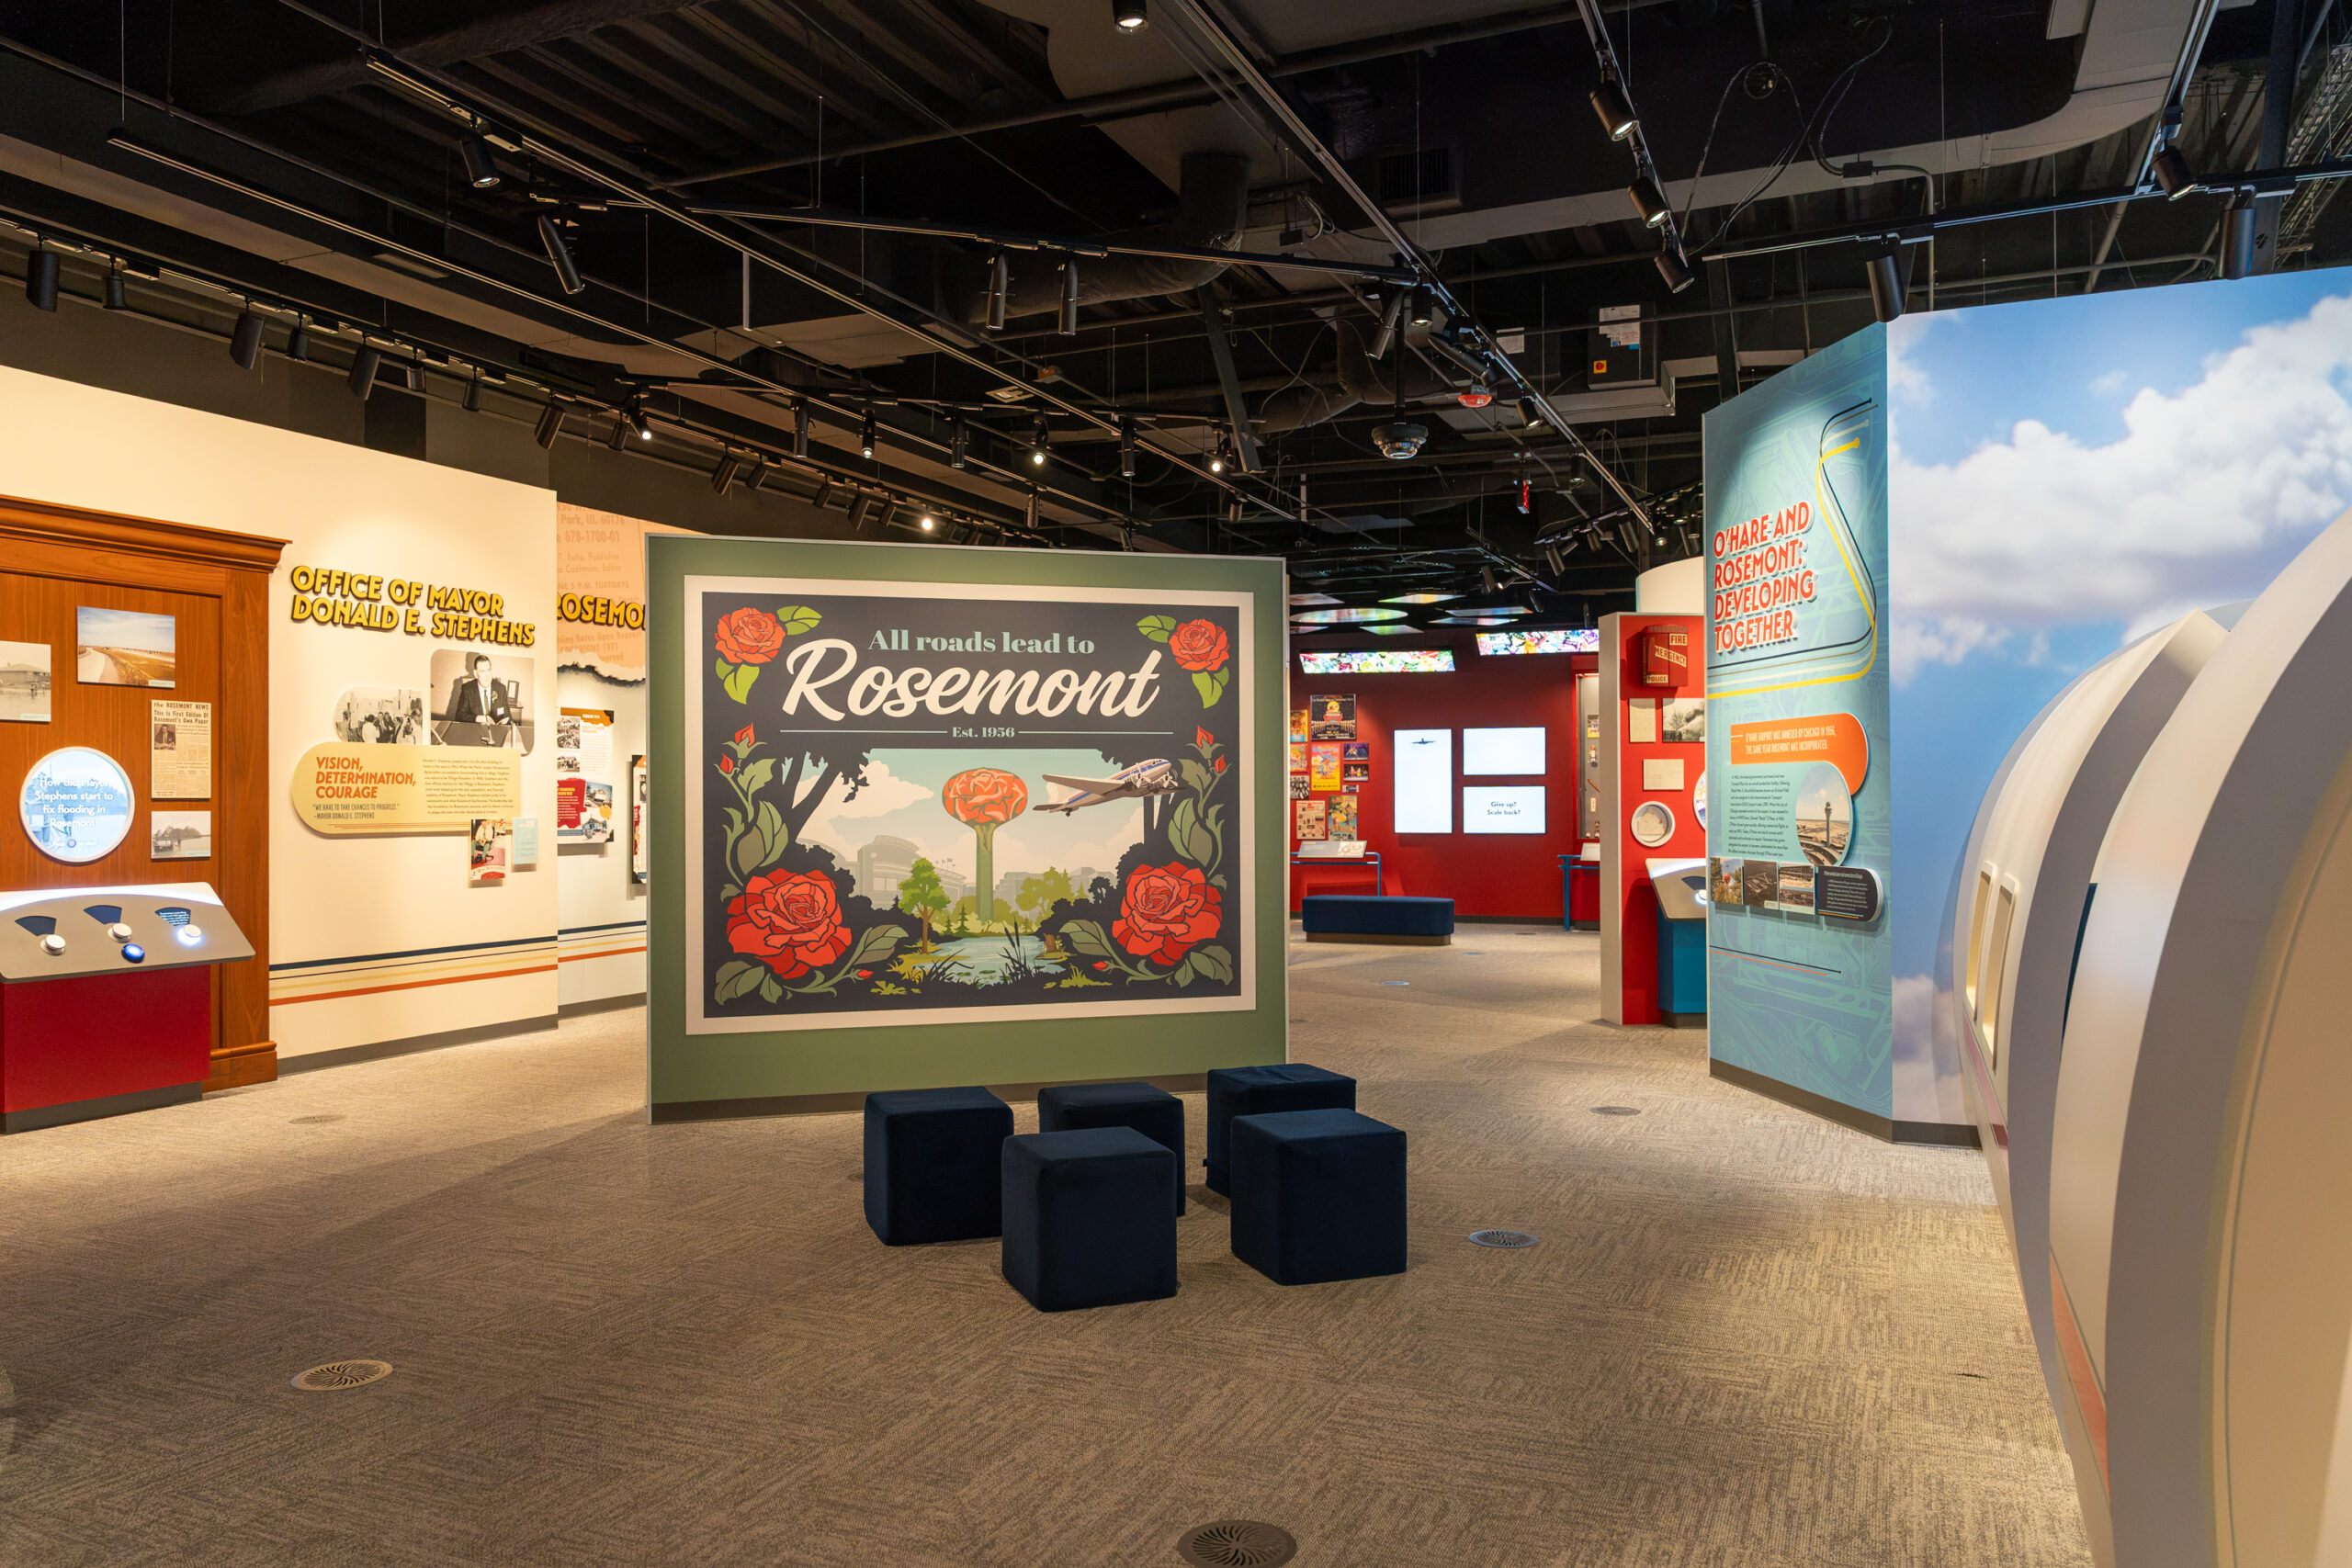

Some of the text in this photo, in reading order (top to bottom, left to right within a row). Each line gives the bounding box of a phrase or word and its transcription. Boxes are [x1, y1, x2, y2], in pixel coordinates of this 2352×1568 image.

[561, 514, 583, 526] Park,
[565, 530, 620, 543] 678-1700-01
[1713, 502, 1809, 558] O'HARE AND
[1714, 538, 1803, 590] ROSEMONT:
[291, 565, 504, 617] OFFICE OF MAYOR
[595, 580, 630, 589] TUESDAYS
[1714, 570, 1814, 620] DEVELOPING
[291, 594, 535, 646] DONALD E. STEPHENS
[1714, 609, 1794, 652] TOGETHER
[869, 629, 1095, 654] All roads lead to
[1671, 635, 1687, 644] FIRE
[781, 638, 1163, 722] Rosemont
[952, 727, 1015, 739] Est. 1956
[1758, 731, 1772, 742] AIRPORT
[1804, 727, 1820, 738] CHICAGO
[1771, 742, 1790, 753] ROSEMONT
[316, 756, 363, 772] VISION,
[316, 771, 416, 787] DETERMINATION,
[35, 791, 78, 802] Stephens
[316, 786, 378, 799] COURAGE
[43, 804, 106, 816] fix flooding in
